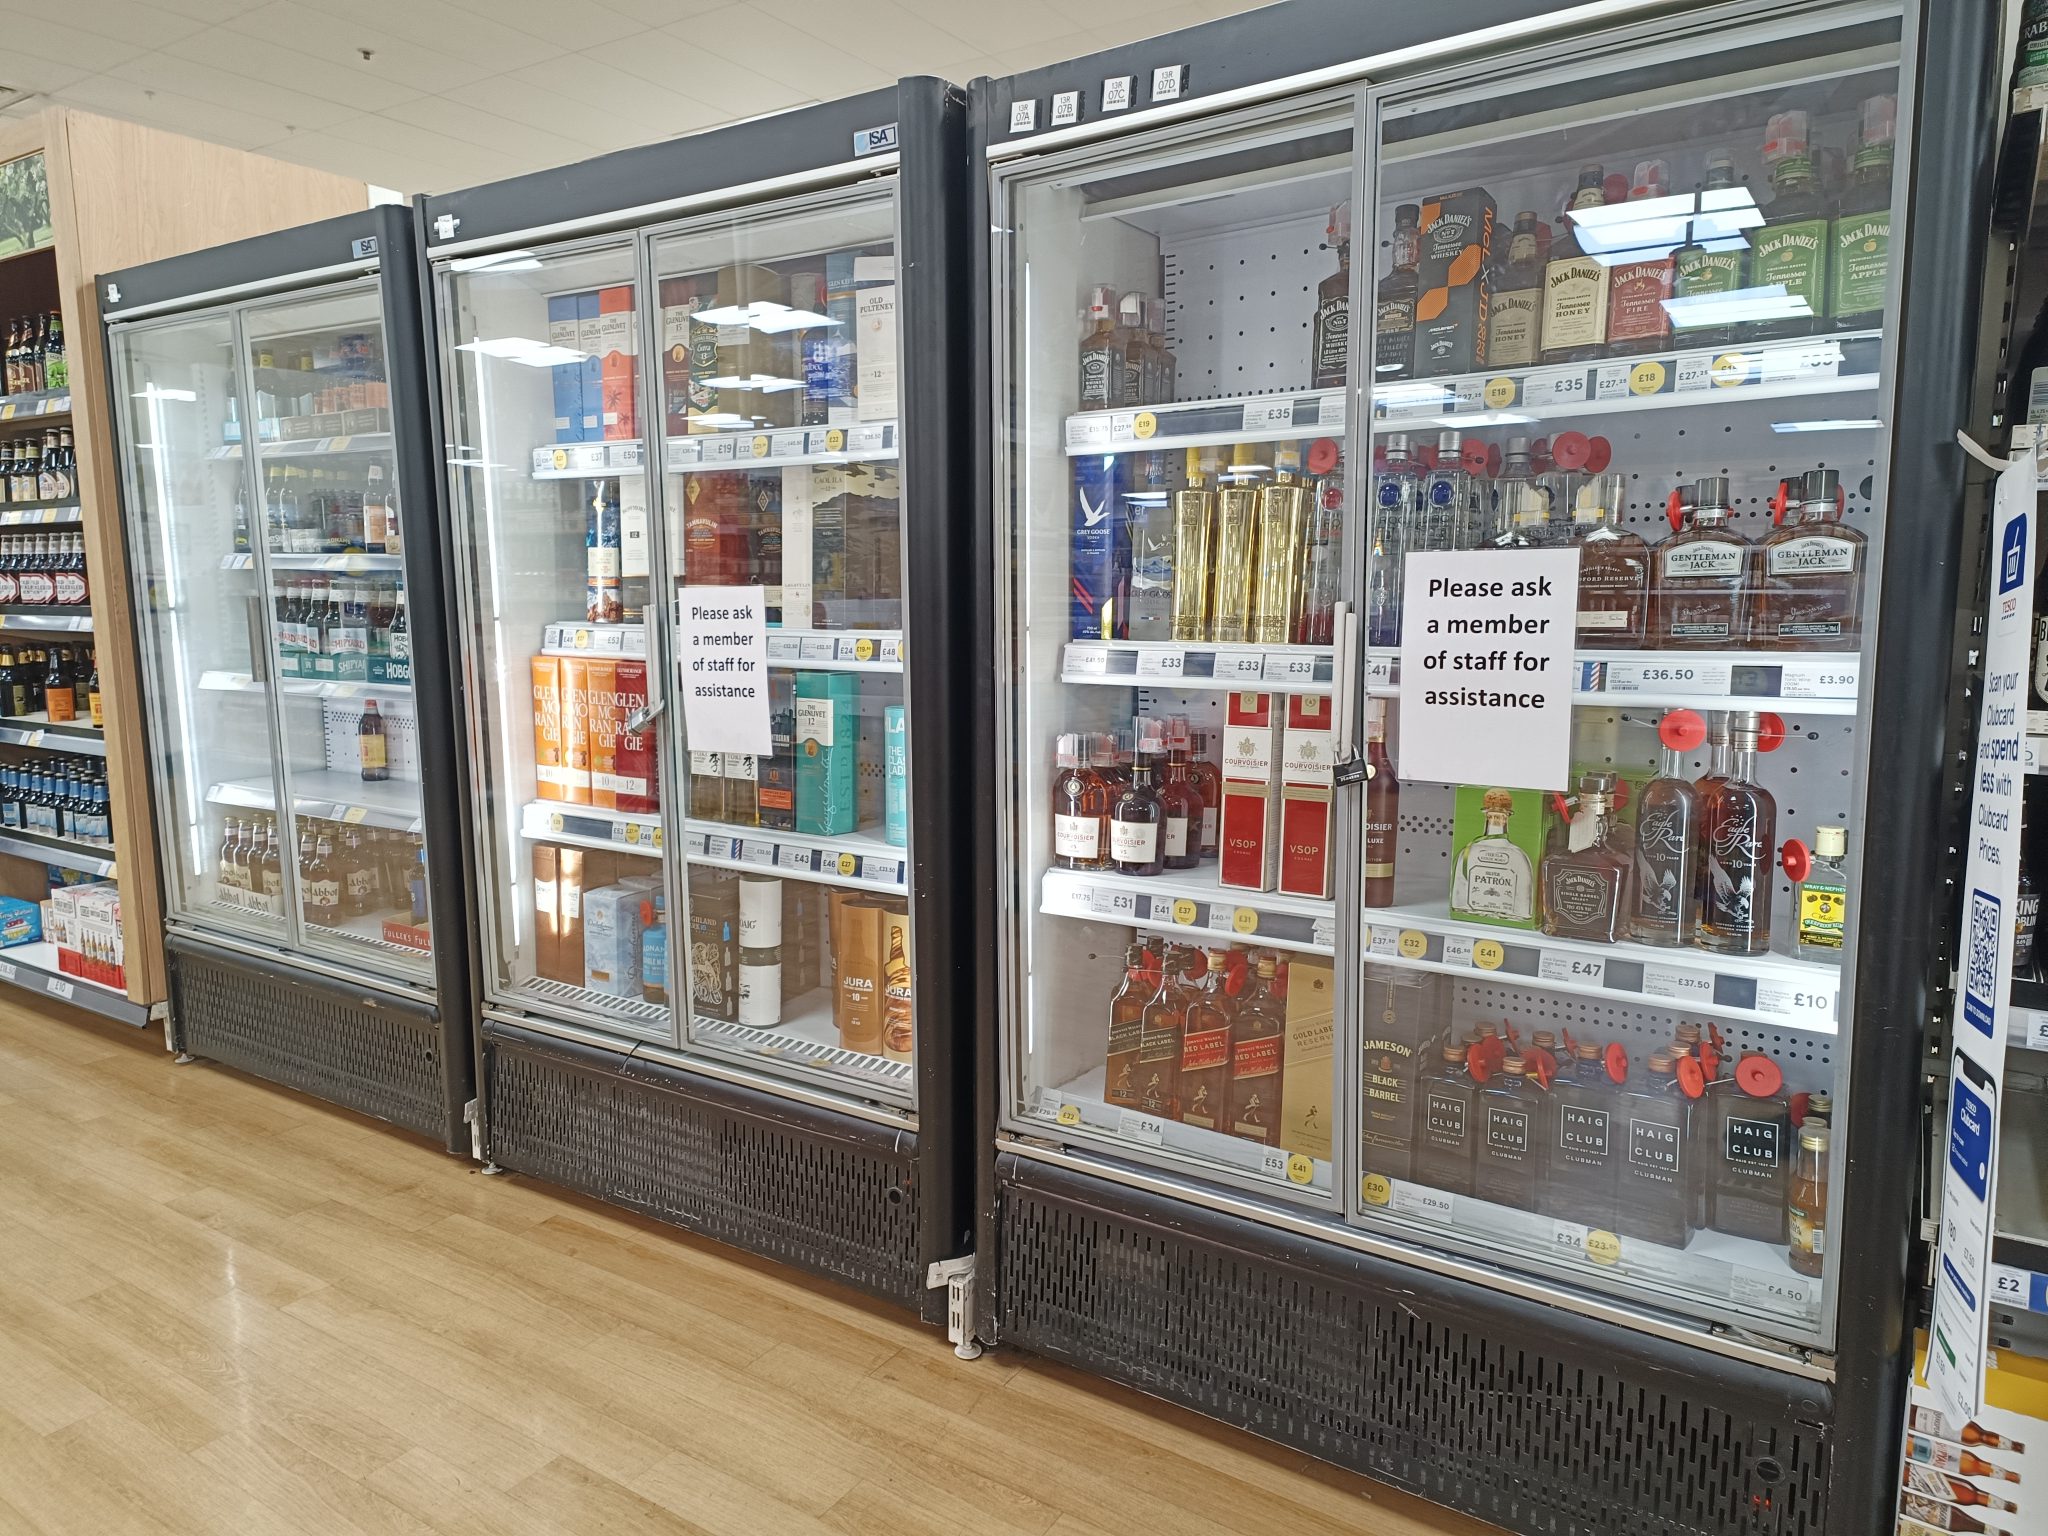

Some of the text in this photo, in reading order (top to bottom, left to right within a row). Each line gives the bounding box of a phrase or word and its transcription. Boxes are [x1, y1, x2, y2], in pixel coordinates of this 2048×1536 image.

[1158, 78, 1175, 90] 07D
[1108, 88, 1125, 100] 07C
[1057, 104, 1073, 114] 07B
[1016, 112, 1030, 122] 07A
[1428, 214, 1472, 234] JACK DANIEL'S
[1759, 234, 1819, 257] JACK DANIEL'S
[1430, 250, 1464, 260] WHISKEY
[1680, 255, 1737, 278] JACK DANIEL'S
[1550, 267, 1600, 288] JACK DANIEL'S
[1614, 266, 1666, 288] JACK DANIEL'S
[1766, 270, 1807, 281] Tennessee
[1851, 269, 1887, 280] APPLE
[860, 303, 894, 313] PULTENEY
[1556, 301, 1591, 311] Tennessee
[1626, 305, 1648, 314] FIRE
[1555, 308, 1591, 318] HONEY
[601, 323, 626, 332] GLENLIVET
[552, 330, 575, 339] GLENLIVET
[1495, 334, 1526, 342] HONEY
[873, 370, 882, 378] 12
[1638, 373, 1656, 383] £18
[1555, 378, 1583, 393] £35
[1492, 388, 1506, 396] £18
[1268, 408, 1290, 420] £35
[1138, 420, 1150, 428] £19
[624, 451, 636, 459] £50
[718, 445, 732, 453] £19
[1671, 552, 1736, 562] GENTLEMAN
[1777, 548, 1848, 559] GENTLEMAN
[1690, 560, 1716, 569] JACK
[1798, 557, 1825, 566] JACK
[1429, 576, 1552, 597] Please ask
[2002, 598, 2016, 613] TESCO
[692, 605, 753, 620] Please ask
[1427, 614, 1550, 634] a member
[693, 632, 753, 646] a member
[840, 646, 853, 655] £24
[882, 648, 896, 656] £48
[693, 657, 755, 672] of staff for
[1162, 657, 1181, 668] £33
[1238, 660, 1259, 671] £33
[1423, 651, 1550, 671] of staff for
[1289, 662, 1311, 673] £33
[1643, 669, 1694, 680] £36.50
[1819, 675, 1854, 685] £3.90
[1988, 671, 2019, 697] Scan your
[695, 684, 755, 698] assistance
[589, 691, 615, 705] GLEN
[615, 693, 644, 707] GLEN
[1425, 687, 1545, 708] assistance
[535, 712, 554, 726] RAN
[798, 710, 826, 718] GLENLIVET
[1987, 704, 2015, 727] Clubcard
[590, 719, 611, 733] RAN
[808, 717, 815, 726] 12
[599, 734, 615, 748] GIE
[624, 736, 643, 751] GIE
[888, 746, 902, 756] THE
[1980, 732, 2019, 768] and spend
[1225, 758, 1269, 767] COURVOISIER
[1285, 761, 1331, 771] COURVOISIER
[626, 780, 635, 790] 12
[1979, 764, 2012, 797] less with
[1978, 804, 2008, 832] Clubcard
[1229, 838, 1257, 850] VSOP
[1289, 845, 1319, 856] VSOP
[1979, 837, 2001, 865] Prices.
[794, 853, 809, 864] £43
[823, 859, 836, 868] £46
[841, 860, 851, 868] £27
[312, 887, 338, 898] Abbot
[1113, 896, 1133, 909] £31
[1154, 905, 1170, 915] £41
[1178, 906, 1191, 915] £37
[1404, 938, 1420, 947] £32
[1480, 948, 1496, 958] £41
[1572, 961, 1602, 977] £47
[55, 980, 65, 993] £10
[844, 976, 873, 988] JURA
[1678, 978, 1710, 989] £37.50
[885, 984, 912, 997] JURA
[851, 993, 860, 1002] 10
[1794, 993, 1827, 1009] £10
[1184, 1041, 1224, 1053] RED LABEL
[1364, 1040, 1412, 1057] JAMESON
[1235, 1049, 1277, 1061] RED LABEL
[1372, 1074, 1398, 1088] BLACK
[1369, 1089, 1400, 1102] BARREL
[1432, 1101, 1461, 1113] HAIG
[1062, 1112, 1074, 1120] £22
[1493, 1115, 1523, 1127] HAIG
[1567, 1113, 1603, 1127] HAIG
[1960, 1107, 1980, 1137] Clubcard
[1141, 1121, 1160, 1133] £34
[1431, 1117, 1461, 1129] CLUB
[1492, 1131, 1523, 1144] CLUB
[1636, 1127, 1674, 1142] HAIG
[1733, 1125, 1773, 1139] HAIG
[1431, 1136, 1460, 1145] CLUBMAN
[1566, 1132, 1603, 1146] CLUB
[1491, 1150, 1522, 1161] CLUBMAN
[1635, 1147, 1674, 1162] CLUB
[1732, 1145, 1773, 1158] CLUB
[1265, 1158, 1283, 1169] £53
[1565, 1154, 1602, 1166] CLUBMAN
[1292, 1164, 1306, 1172] £41
[1732, 1167, 1772, 1179] CLUBMAN
[1634, 1169, 1673, 1183] CLUBMAN
[1367, 1182, 1384, 1193] £30
[1422, 1197, 1449, 1209] £29.50
[1557, 1233, 1581, 1248] £34
[1997, 1276, 2020, 1293] £2
[1768, 1285, 1803, 1301] £4.50
